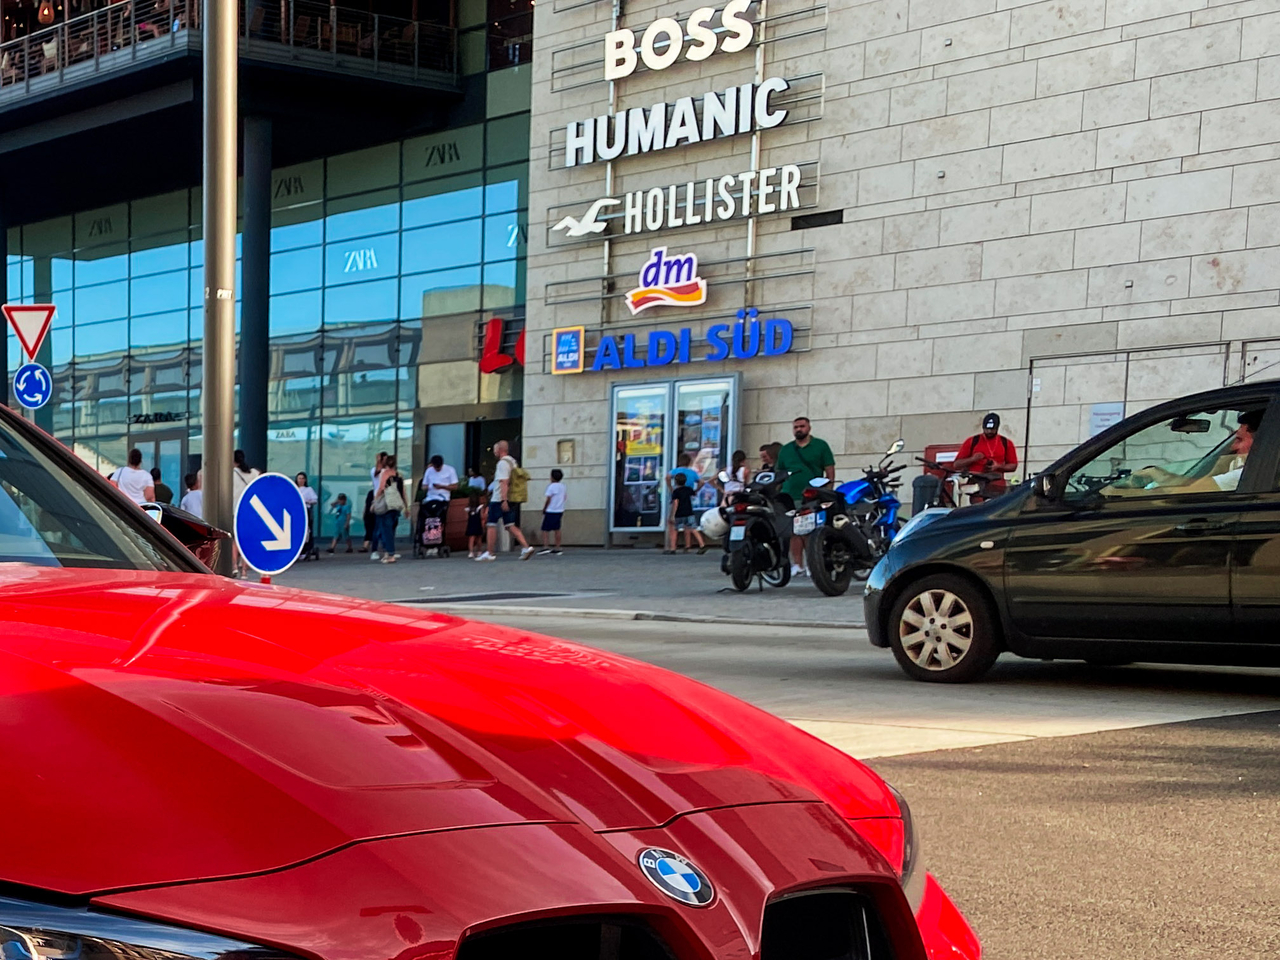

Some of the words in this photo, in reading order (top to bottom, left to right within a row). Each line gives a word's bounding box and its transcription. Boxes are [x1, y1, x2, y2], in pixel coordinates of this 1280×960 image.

[605, 0, 754, 80] BOSS
[565, 77, 790, 167] HUMANIC
[424, 141, 460, 167] ZARA
[274, 174, 305, 199] ZARA
[624, 164, 802, 234] HOLLISTER
[344, 247, 379, 273] ZARA
[642, 250, 696, 288] dm
[592, 327, 692, 371] ALDI
[706, 308, 794, 361] SÜD
[557, 352, 579, 363] ALDI
[643, 849, 688, 869] BMW
